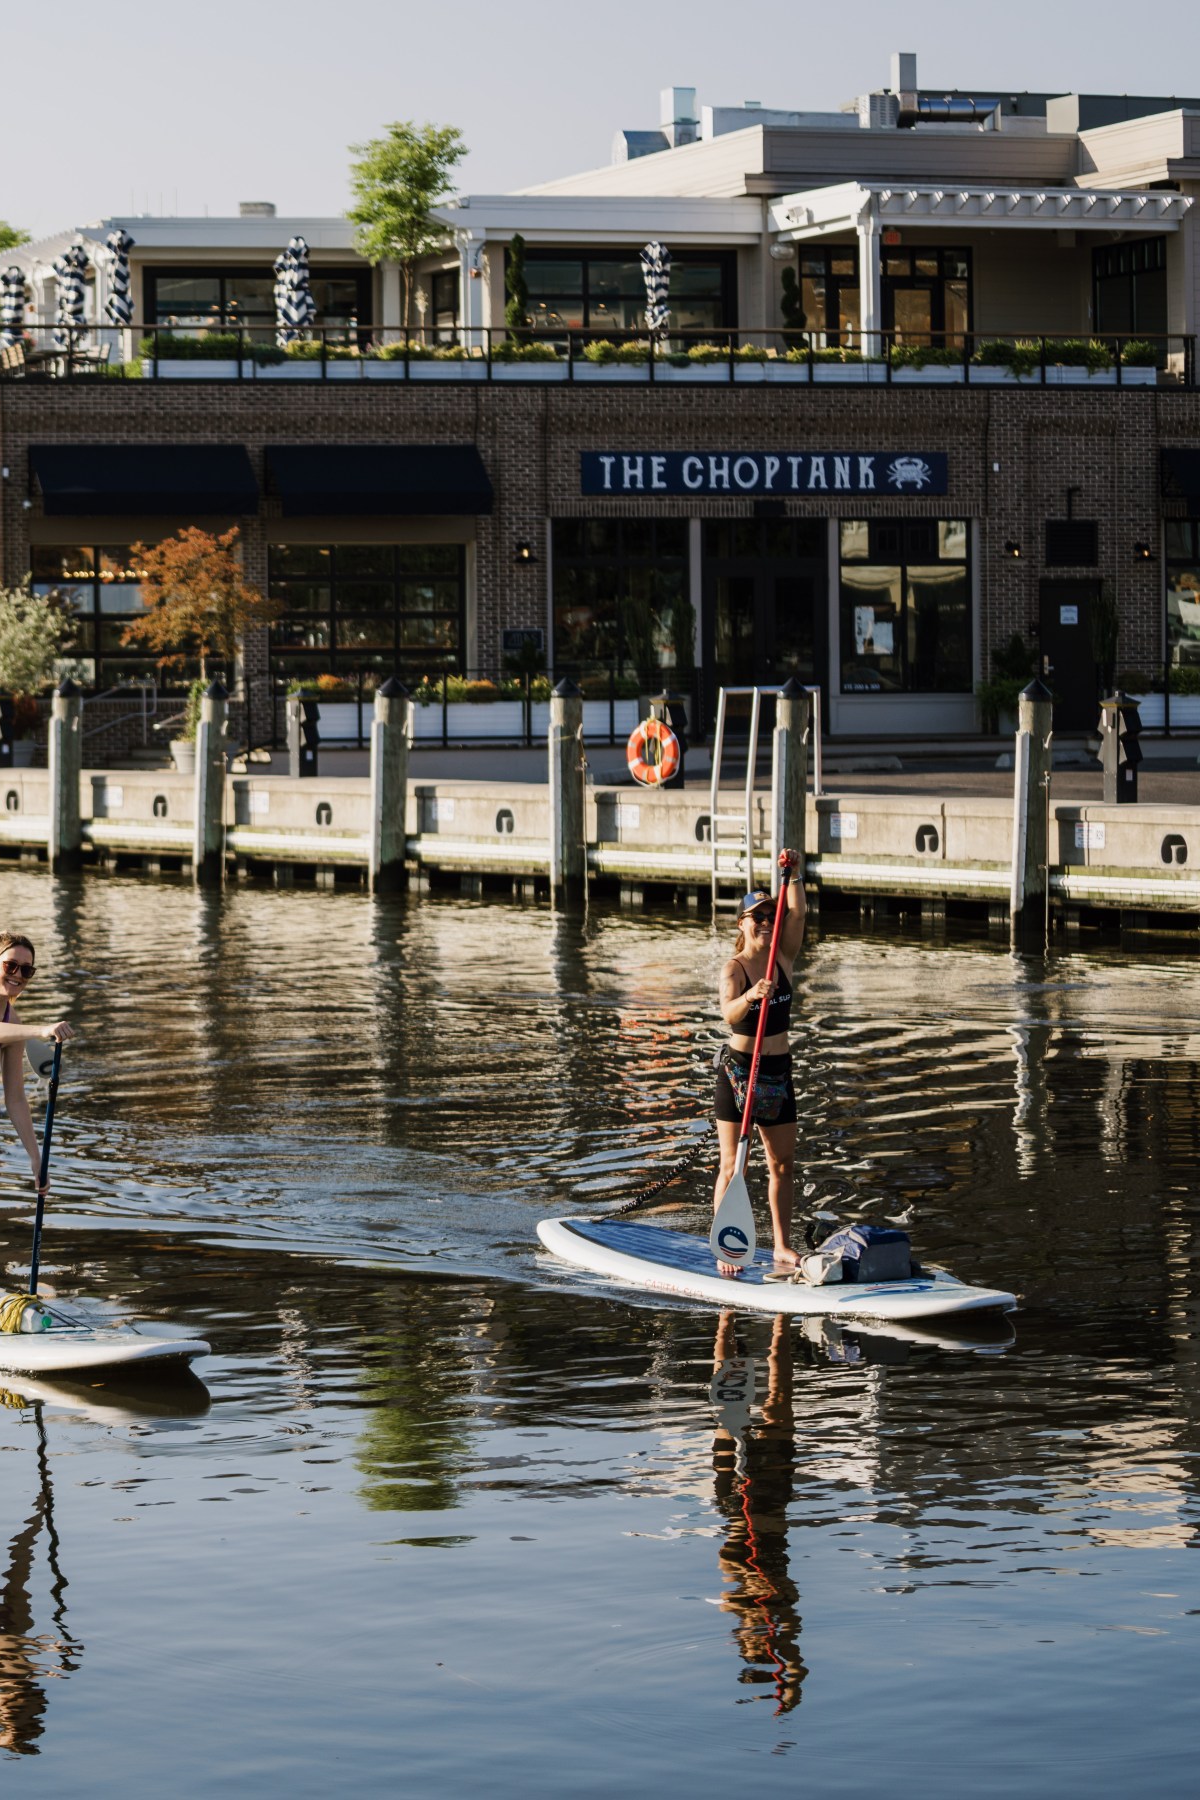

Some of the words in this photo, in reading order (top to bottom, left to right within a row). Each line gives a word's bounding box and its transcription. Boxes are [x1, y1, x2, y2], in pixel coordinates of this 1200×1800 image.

[599, 456, 668, 489] THE
[682, 456, 877, 489] CHOPTANK
[779, 994, 790, 1002] SUP
